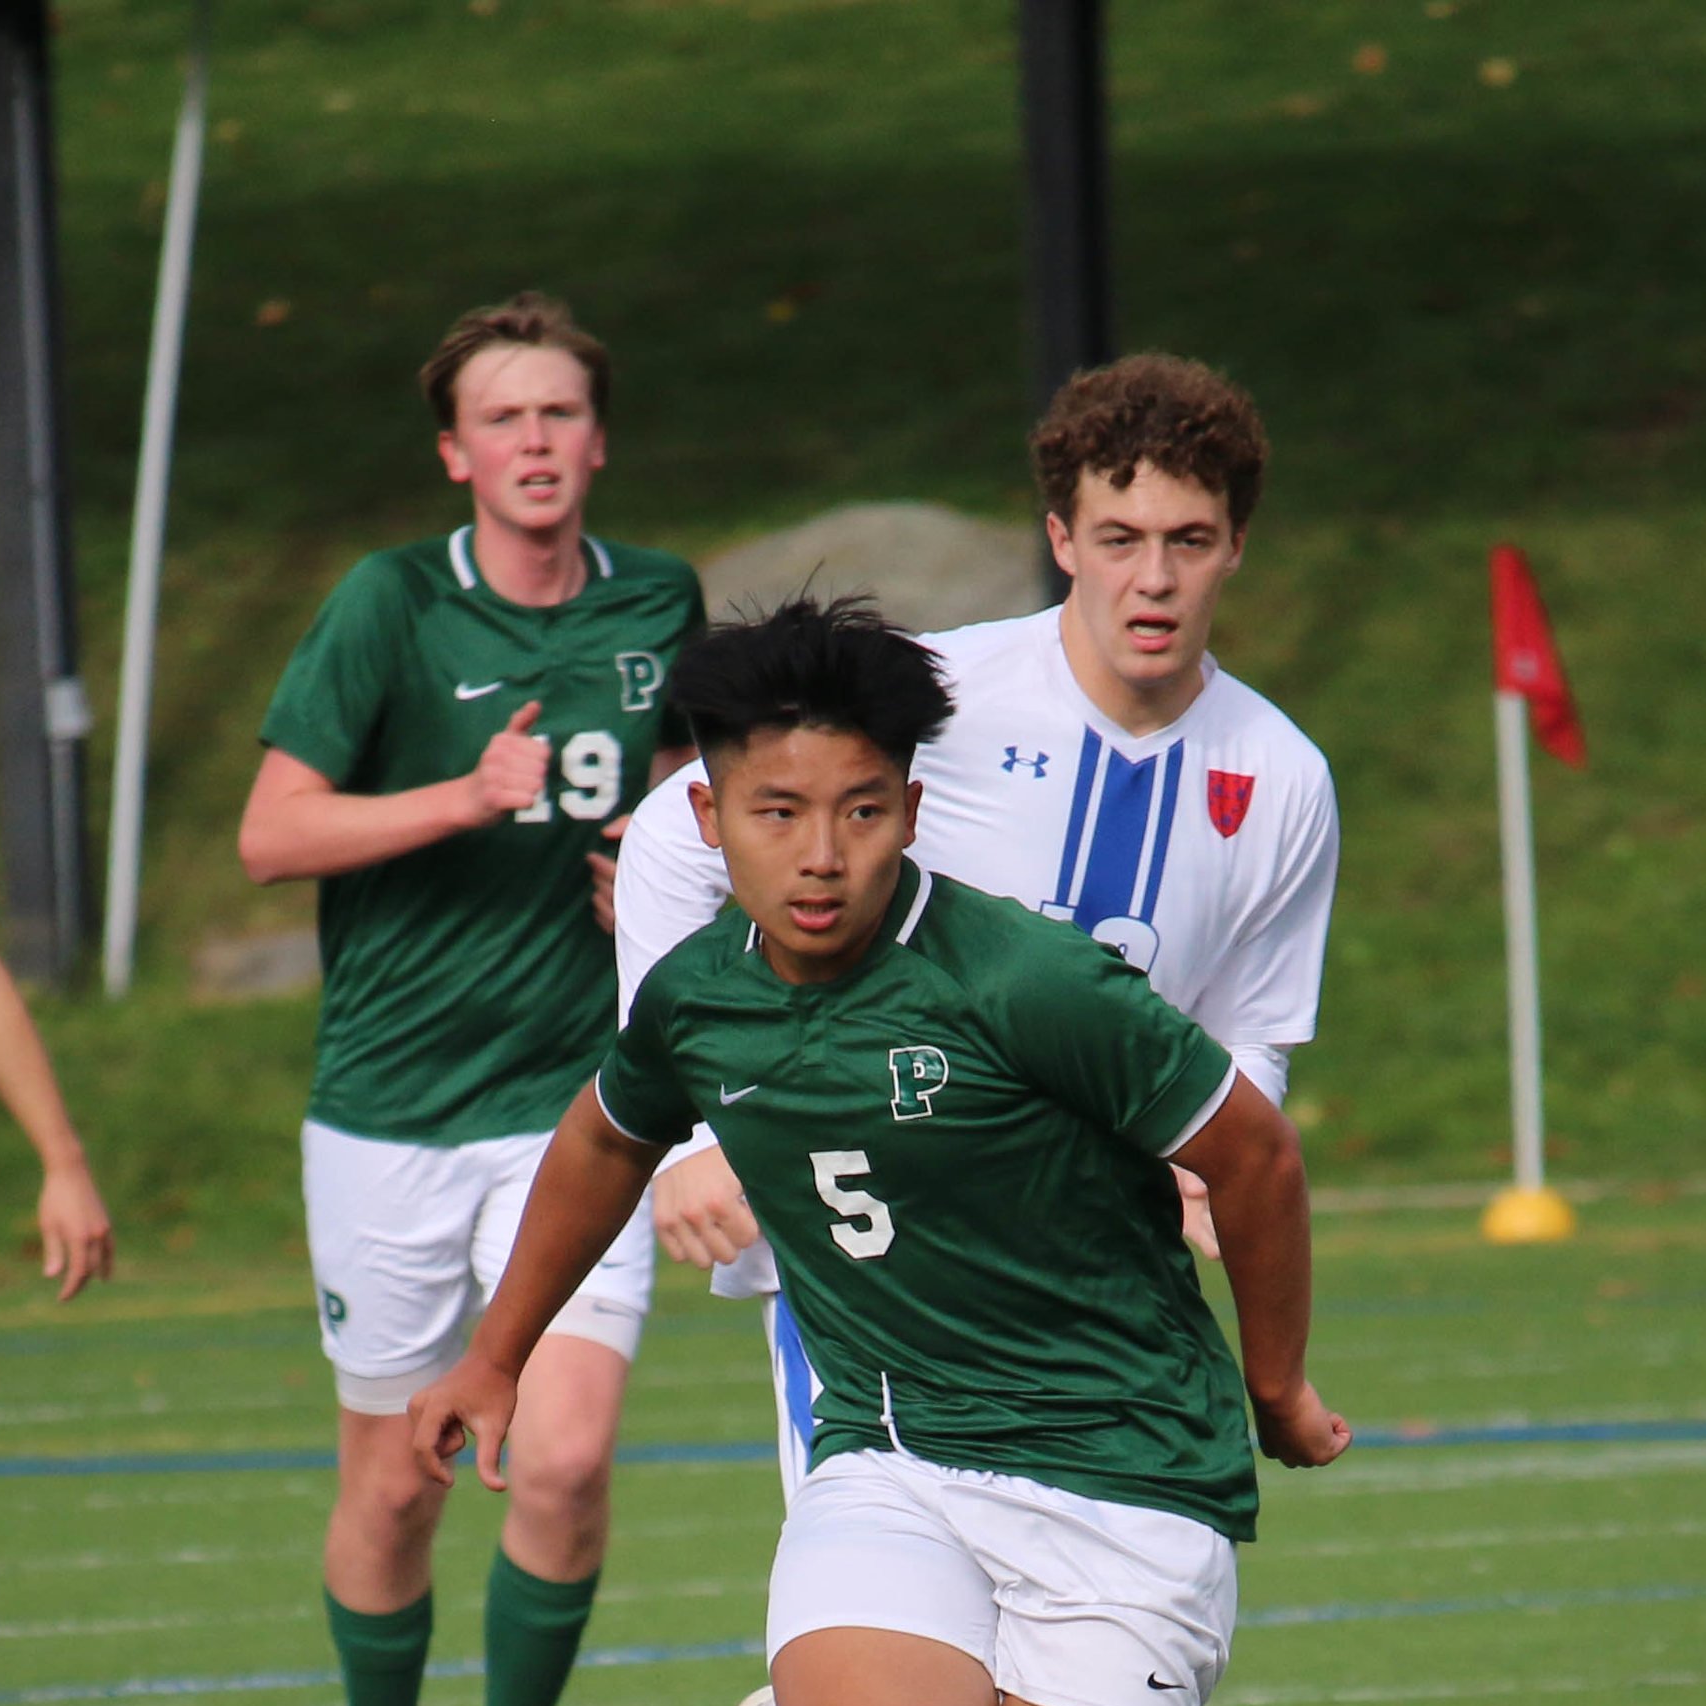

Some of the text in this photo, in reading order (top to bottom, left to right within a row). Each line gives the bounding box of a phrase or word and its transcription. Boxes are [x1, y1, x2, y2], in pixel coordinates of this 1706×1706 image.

[615, 651, 665, 712] P
[888, 1044, 950, 1122] P
[809, 1149, 896, 1261] 5
